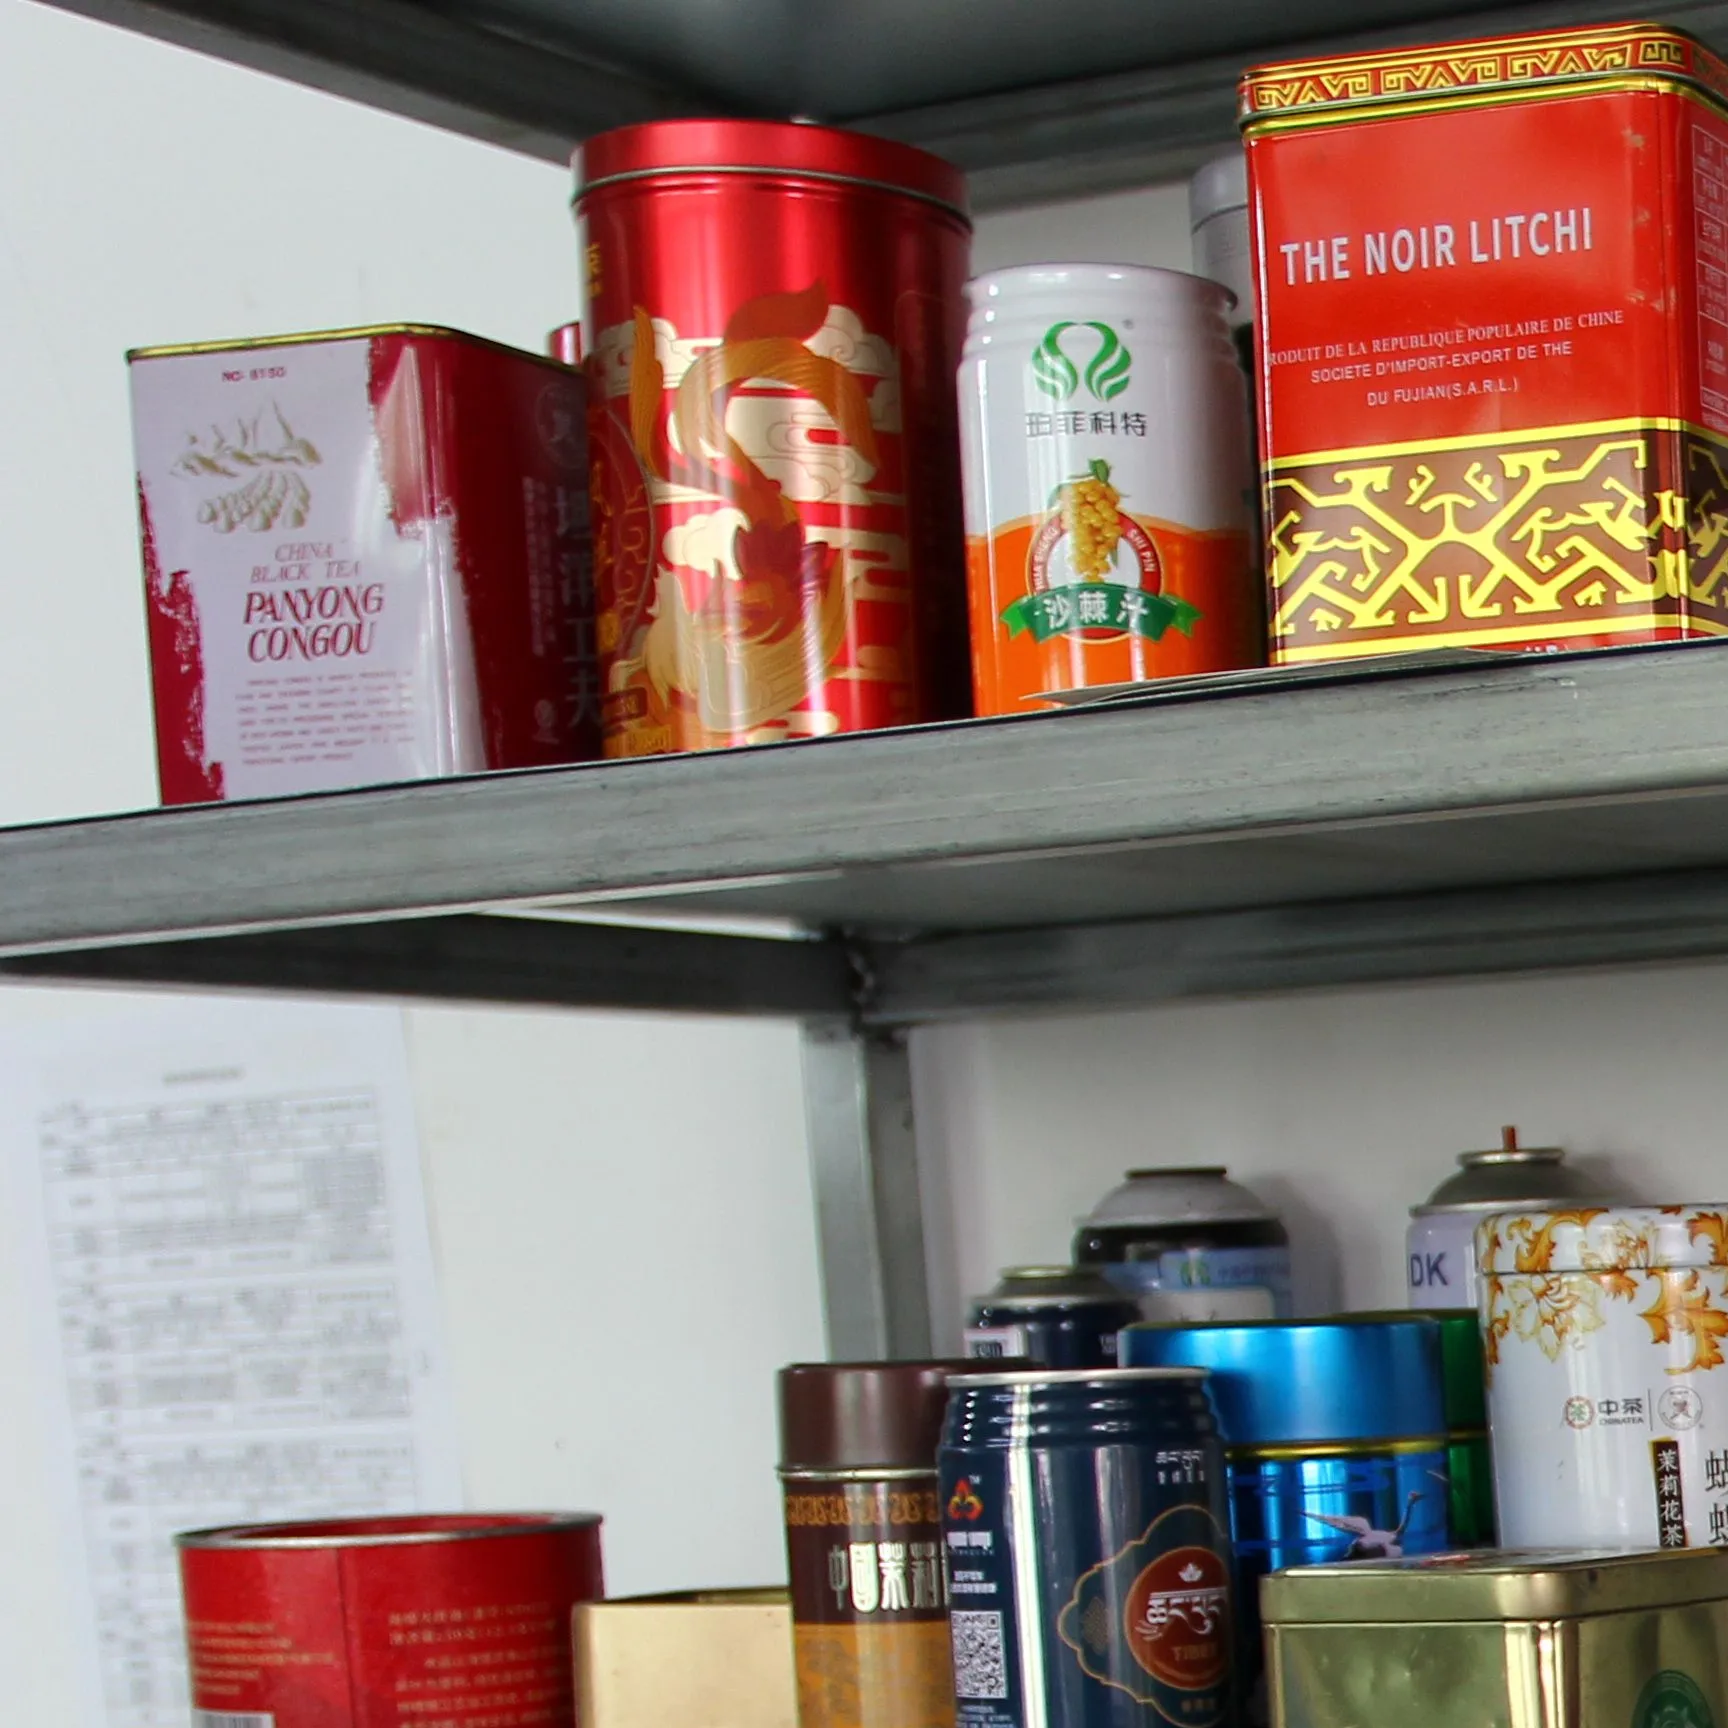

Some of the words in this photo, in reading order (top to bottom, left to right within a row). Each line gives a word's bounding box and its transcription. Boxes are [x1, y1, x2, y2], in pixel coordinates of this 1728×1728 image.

[1280, 237, 1351, 286] THE
[1365, 223, 1457, 275] NOIR
[1469, 206, 1594, 265] LITCHI
[1326, 342, 1345, 361] DE
[1347, 339, 1368, 358] LA
[1371, 326, 1465, 356] REPUBLIQUE
[1466, 317, 1550, 345] POPULAIRE
[1552, 314, 1574, 333] DE
[1577, 308, 1625, 330] CHINE
[1310, 361, 1373, 384] SOCIETE
[1375, 348, 1513, 378] D'IMPORT-EXPORT
[1516, 341, 1538, 360] DE
[1542, 340, 1573, 358] THE
[1366, 388, 1389, 408] DU
[250, 563, 311, 584] BLACK
[325, 560, 361, 579] TEA
[274, 542, 334, 562] CHINA
[243, 583, 386, 625] PANYONG
[1043, 590, 1150, 632] 沙棘汁
[247, 622, 378, 664] CONGOU
[1598, 1398, 1643, 1416] 中茶
[1657, 1448, 1685, 1546] 茉莉花茶
